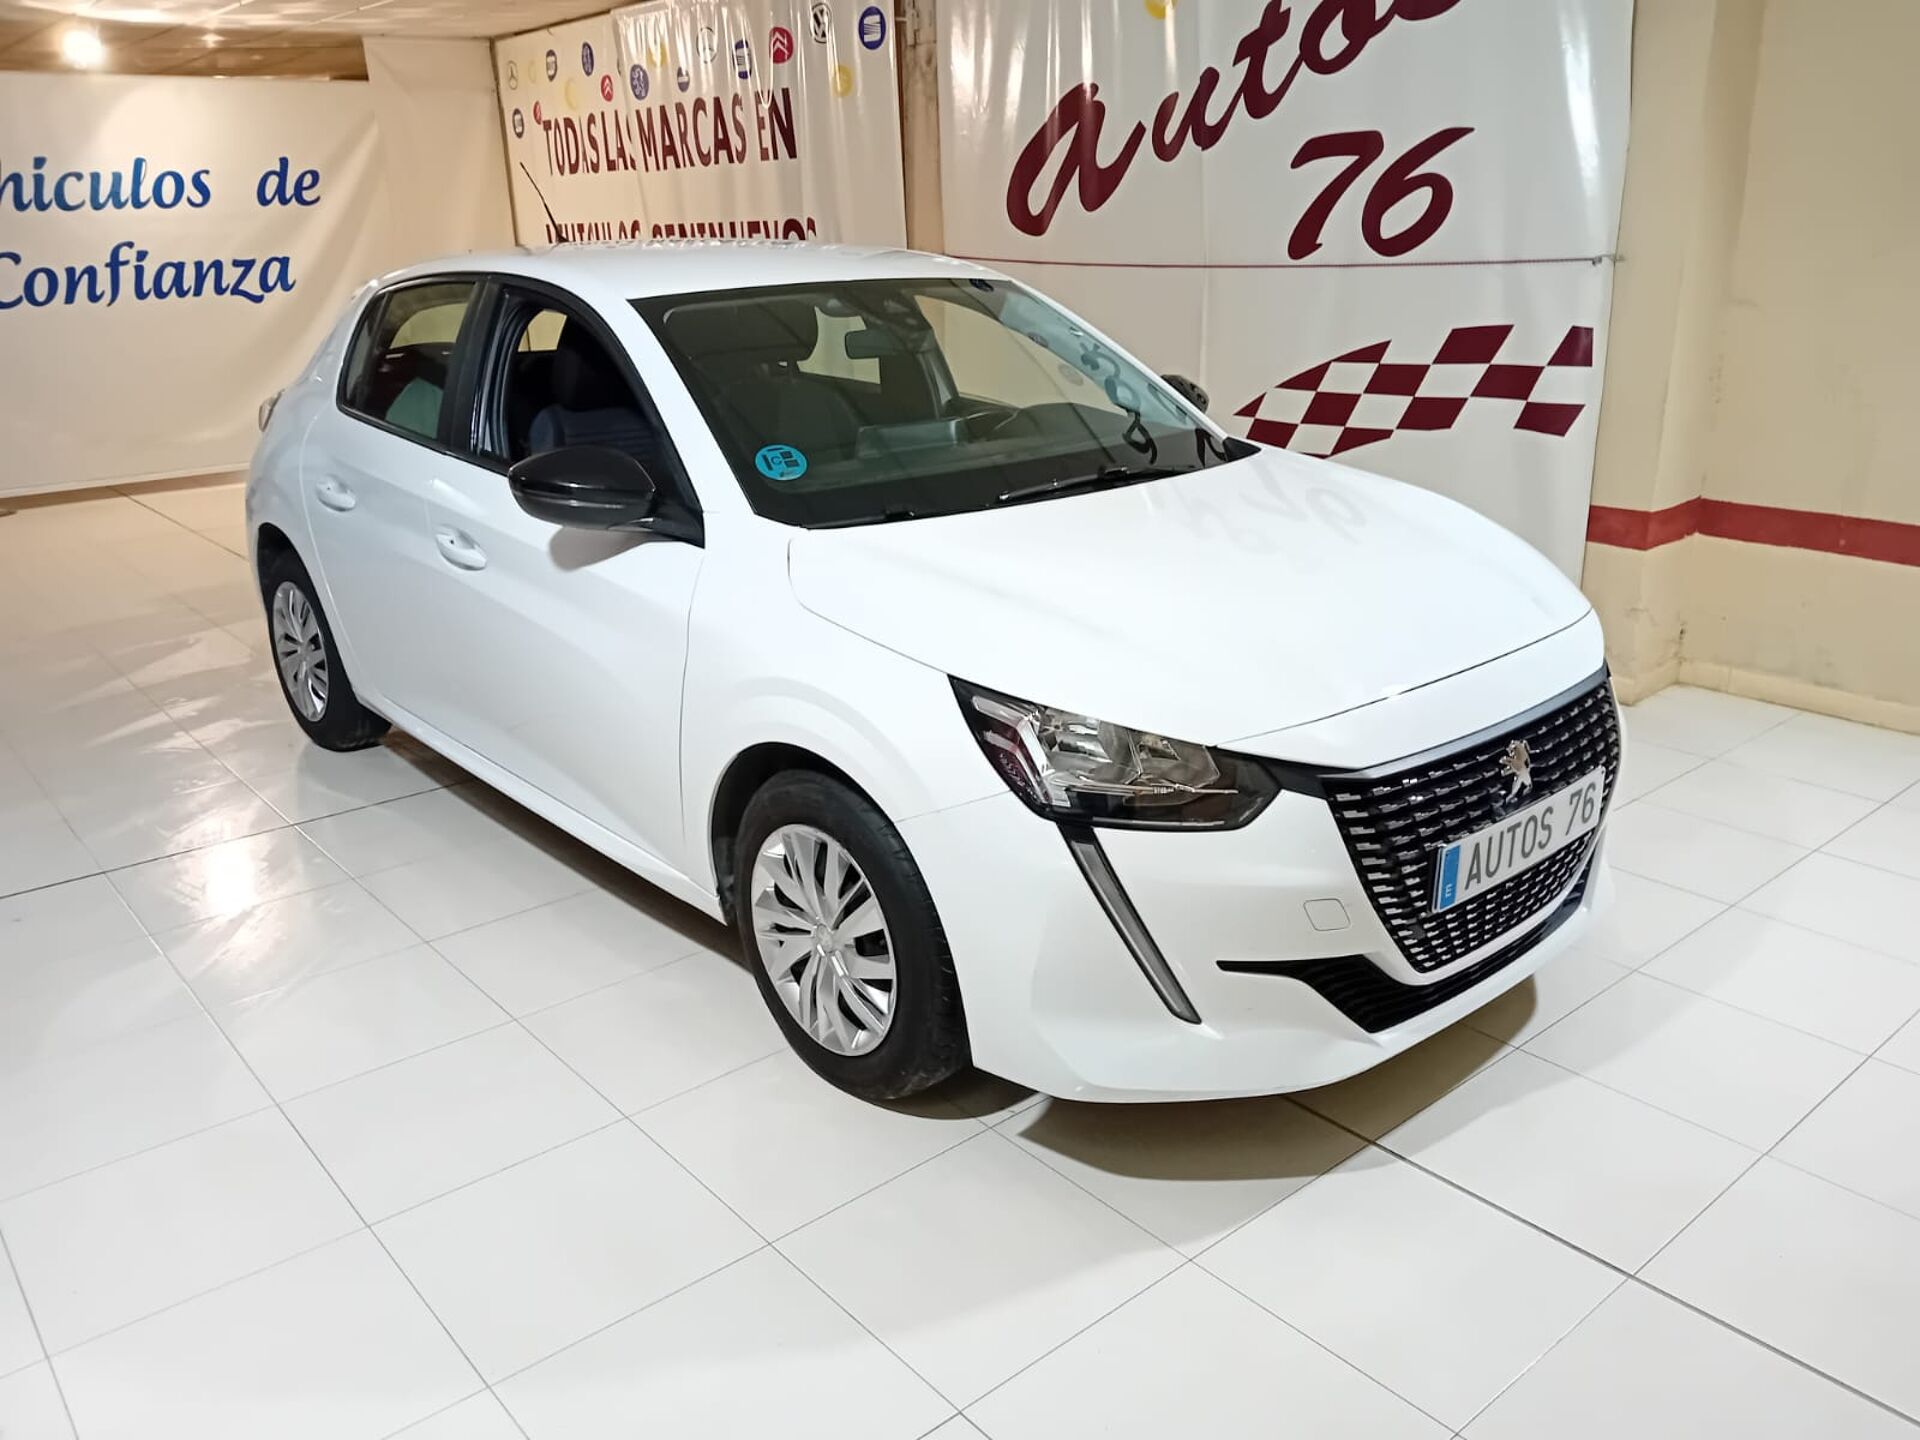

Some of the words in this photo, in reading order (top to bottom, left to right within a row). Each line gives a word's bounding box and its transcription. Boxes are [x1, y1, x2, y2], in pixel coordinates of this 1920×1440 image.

[635, 92, 747, 173] MARCAS
[754, 87, 798, 162] EN
[1006, 0, 1461, 236] Auto
[256, 157, 321, 207] de
[1288, 127, 1475, 260] 76
[1464, 806, 1553, 890] AUTOS
[1565, 782, 1597, 836] 76
